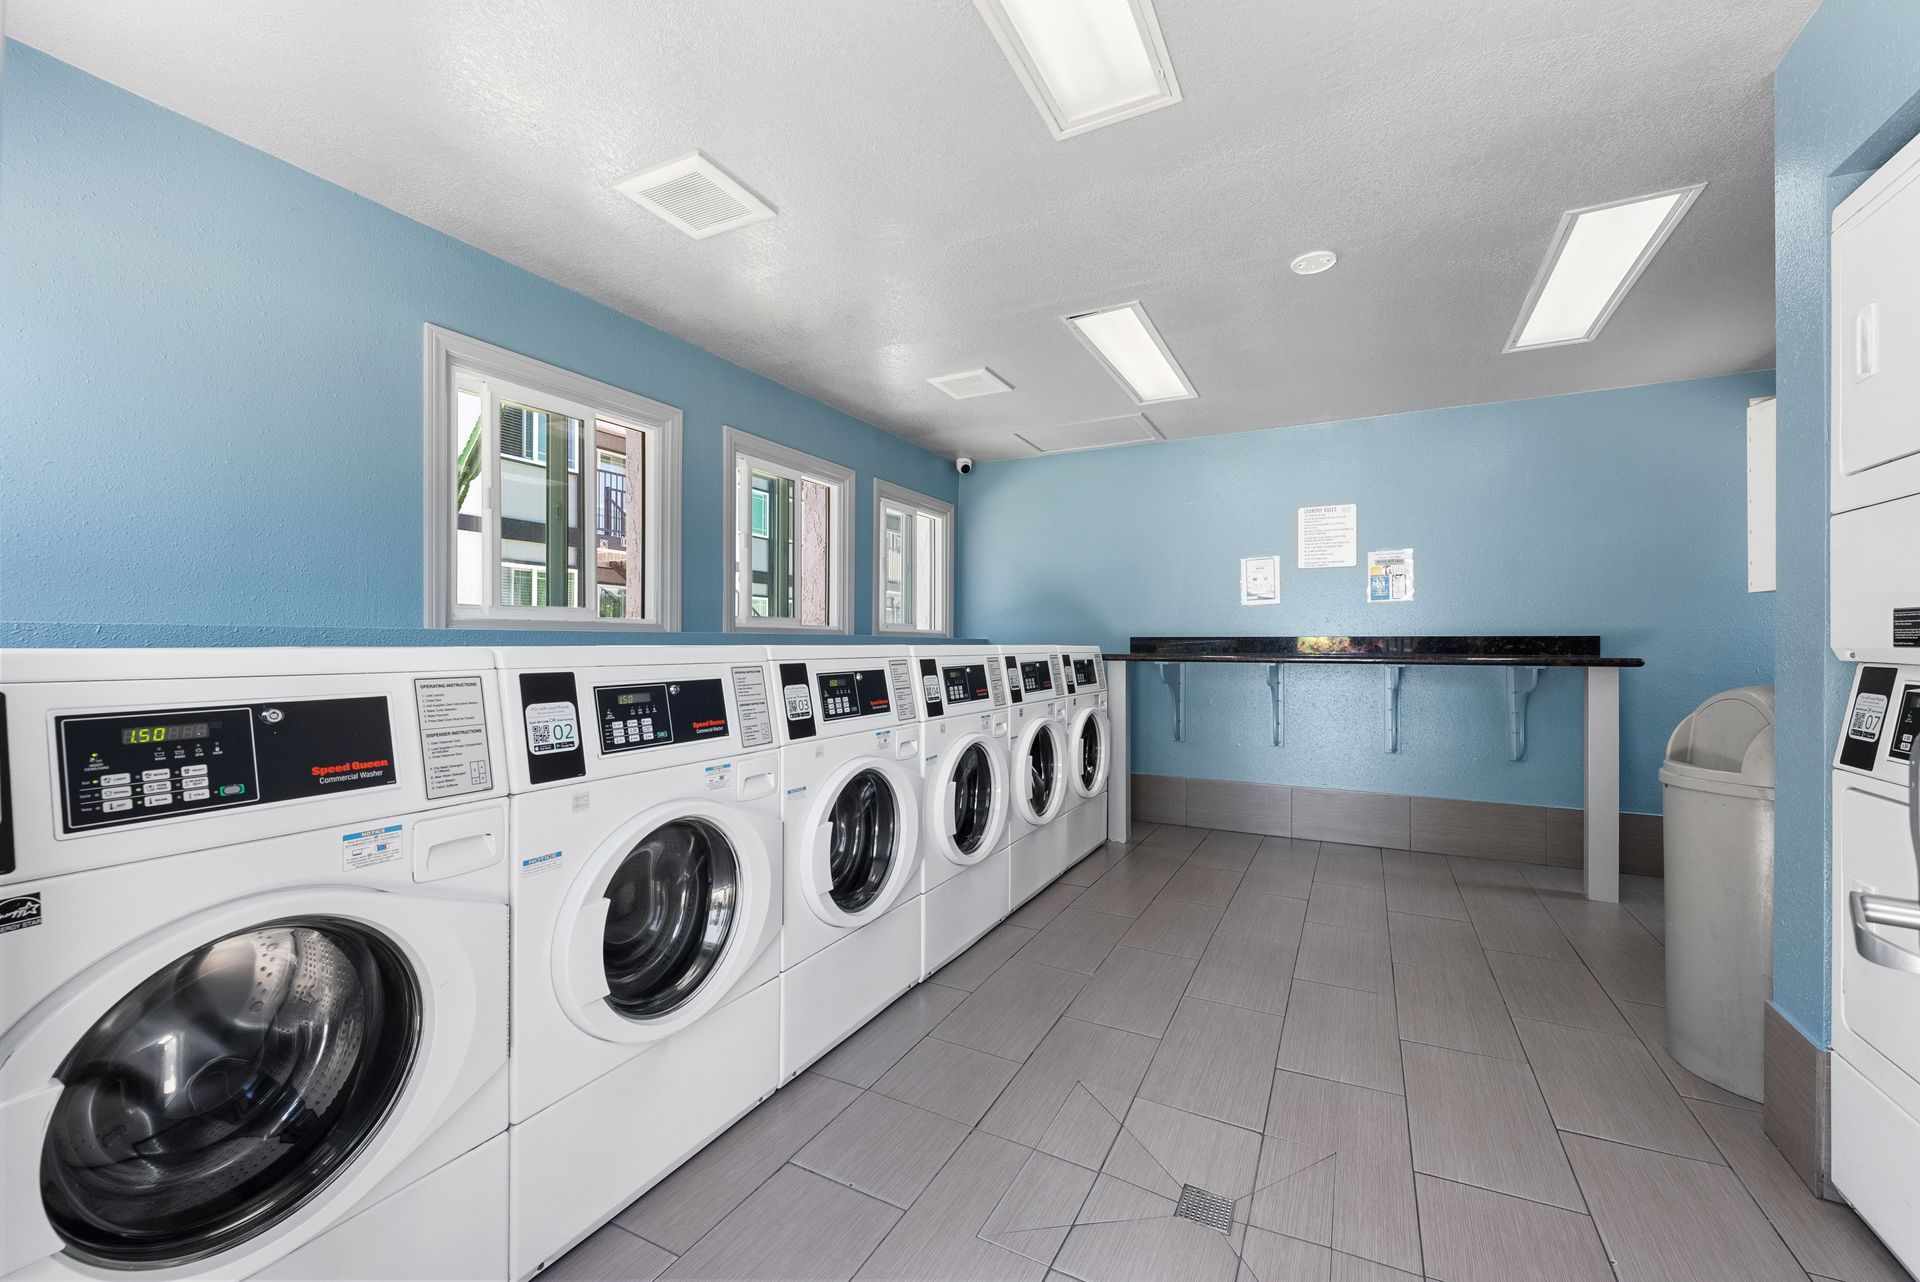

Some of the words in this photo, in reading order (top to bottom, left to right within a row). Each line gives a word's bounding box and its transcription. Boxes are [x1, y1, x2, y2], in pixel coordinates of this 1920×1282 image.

[799, 700, 810, 710] 03
[692, 721, 710, 729] Speed
[1865, 715, 1880, 730] 07
[130, 727, 165, 743] 1.50
[553, 724, 574, 740] 02
[312, 762, 350, 776] Speed
[352, 760, 388, 770] Queen
[320, 773, 358, 784] Commercial
[360, 770, 383, 778] Washer
[362, 828, 384, 838] NOTICE
[529, 854, 554, 864] NOTICE
[22, 919, 41, 928] STAR
